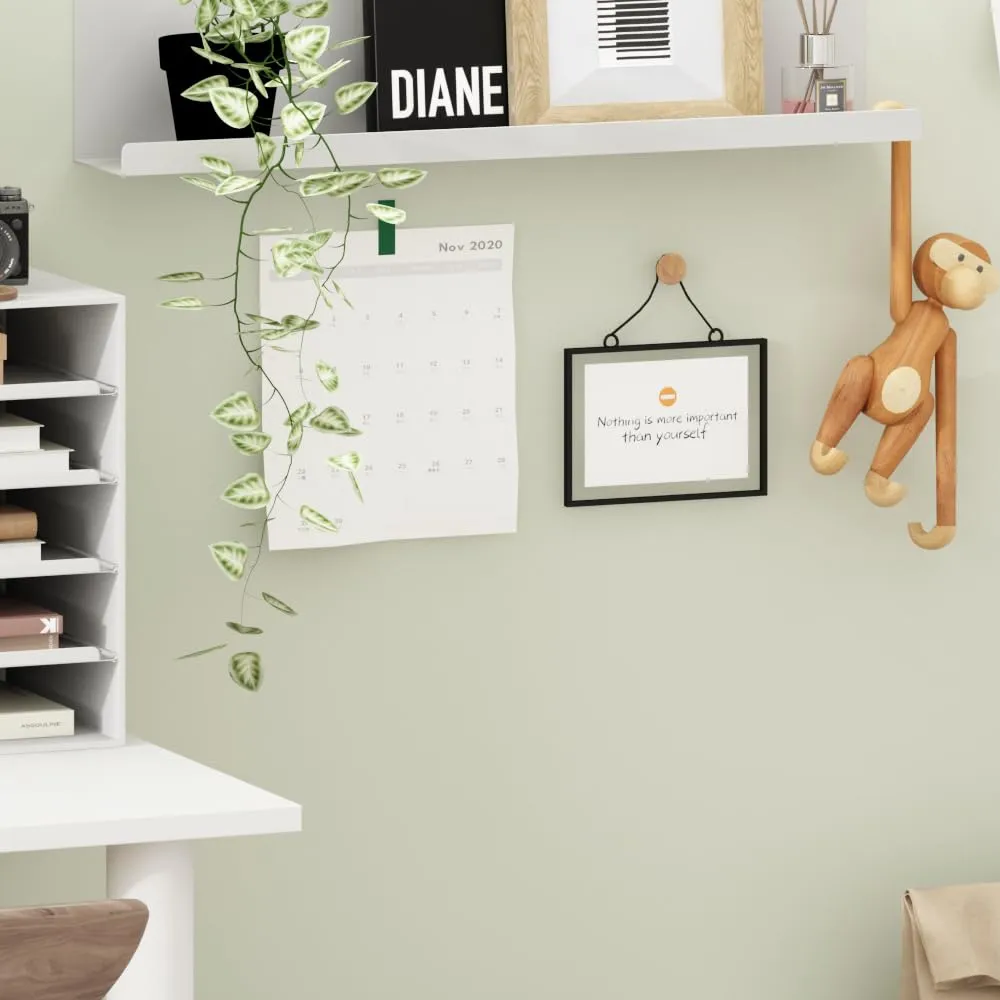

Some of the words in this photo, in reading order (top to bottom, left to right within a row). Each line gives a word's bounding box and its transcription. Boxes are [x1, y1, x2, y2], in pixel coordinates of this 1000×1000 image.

[391, 65, 504, 119] DIANE
[438, 242, 465, 253] Nov
[470, 239, 503, 251] 2020
[597, 416, 641, 430] Nothing
[644, 415, 653, 425] is
[657, 414, 682, 424] more
[686, 411, 738, 426] important
[622, 431, 652, 443] than
[656, 422, 709, 446] yourself
